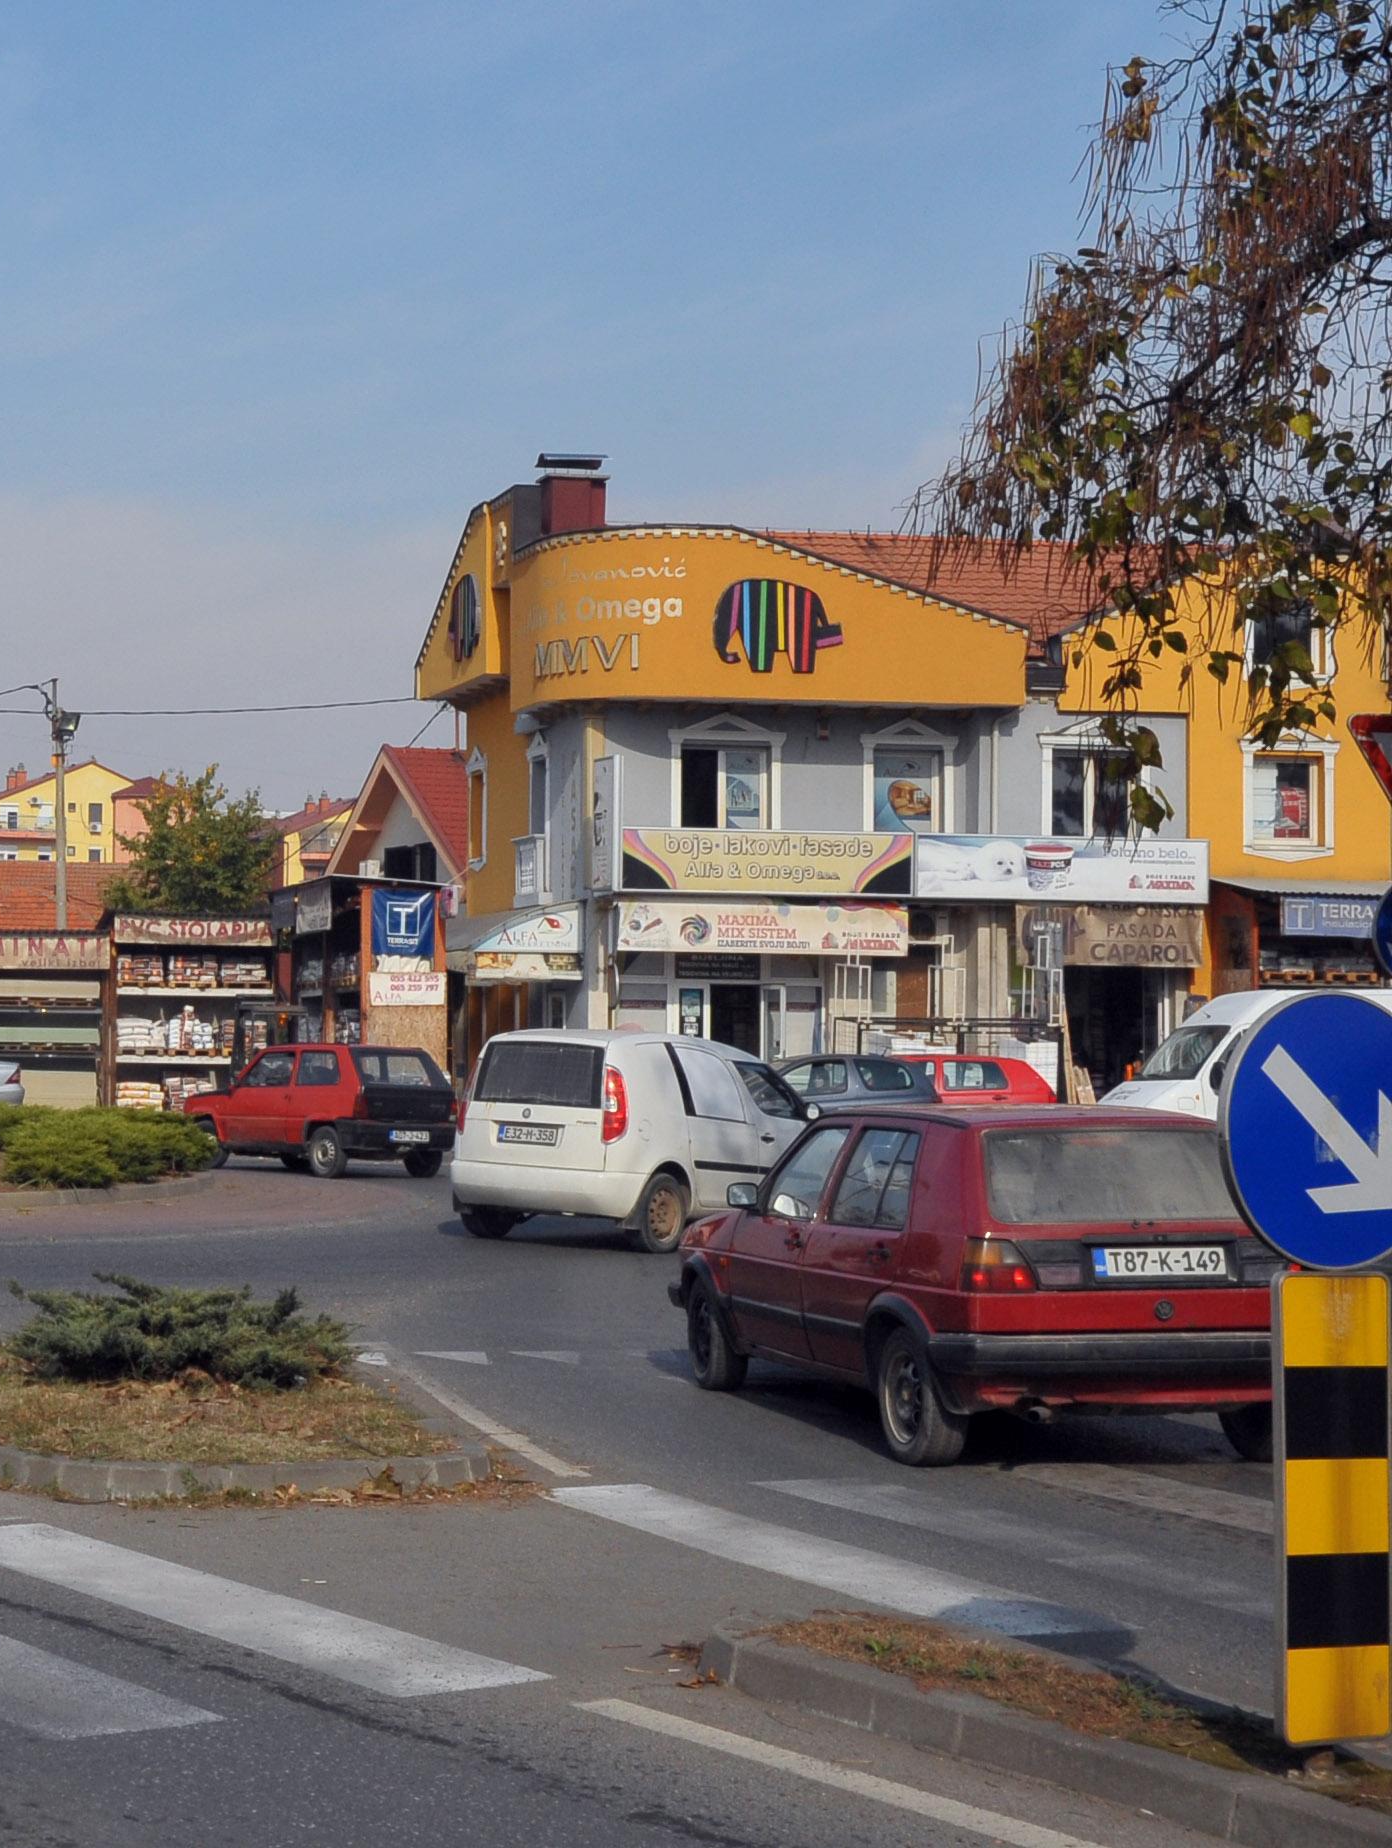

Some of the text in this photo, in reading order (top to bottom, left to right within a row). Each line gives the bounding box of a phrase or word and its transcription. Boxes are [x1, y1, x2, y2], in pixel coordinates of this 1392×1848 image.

[576, 595, 683, 625] Omega
[534, 632, 641, 679] MMVI
[664, 832, 712, 859] boje
[799, 836, 873, 857] fasade
[685, 861, 723, 878] Alfa
[728, 862, 741, 878] &
[746, 862, 815, 883] Omega
[1319, 903, 1377, 918] TERRA
[119, 917, 162, 935] PVC
[717, 915, 778, 926] MAXIMA
[497, 928, 538, 945] ALFA
[717, 928, 797, 939] MIX SISTEM
[1106, 923, 1177, 939] FASADA
[717, 940, 757, 948] IZABERITE
[759, 941, 784, 949] SVOJU
[1090, 943, 1194, 964] CAPAROL
[1108, 1250, 1221, 1273] T87-K-149
